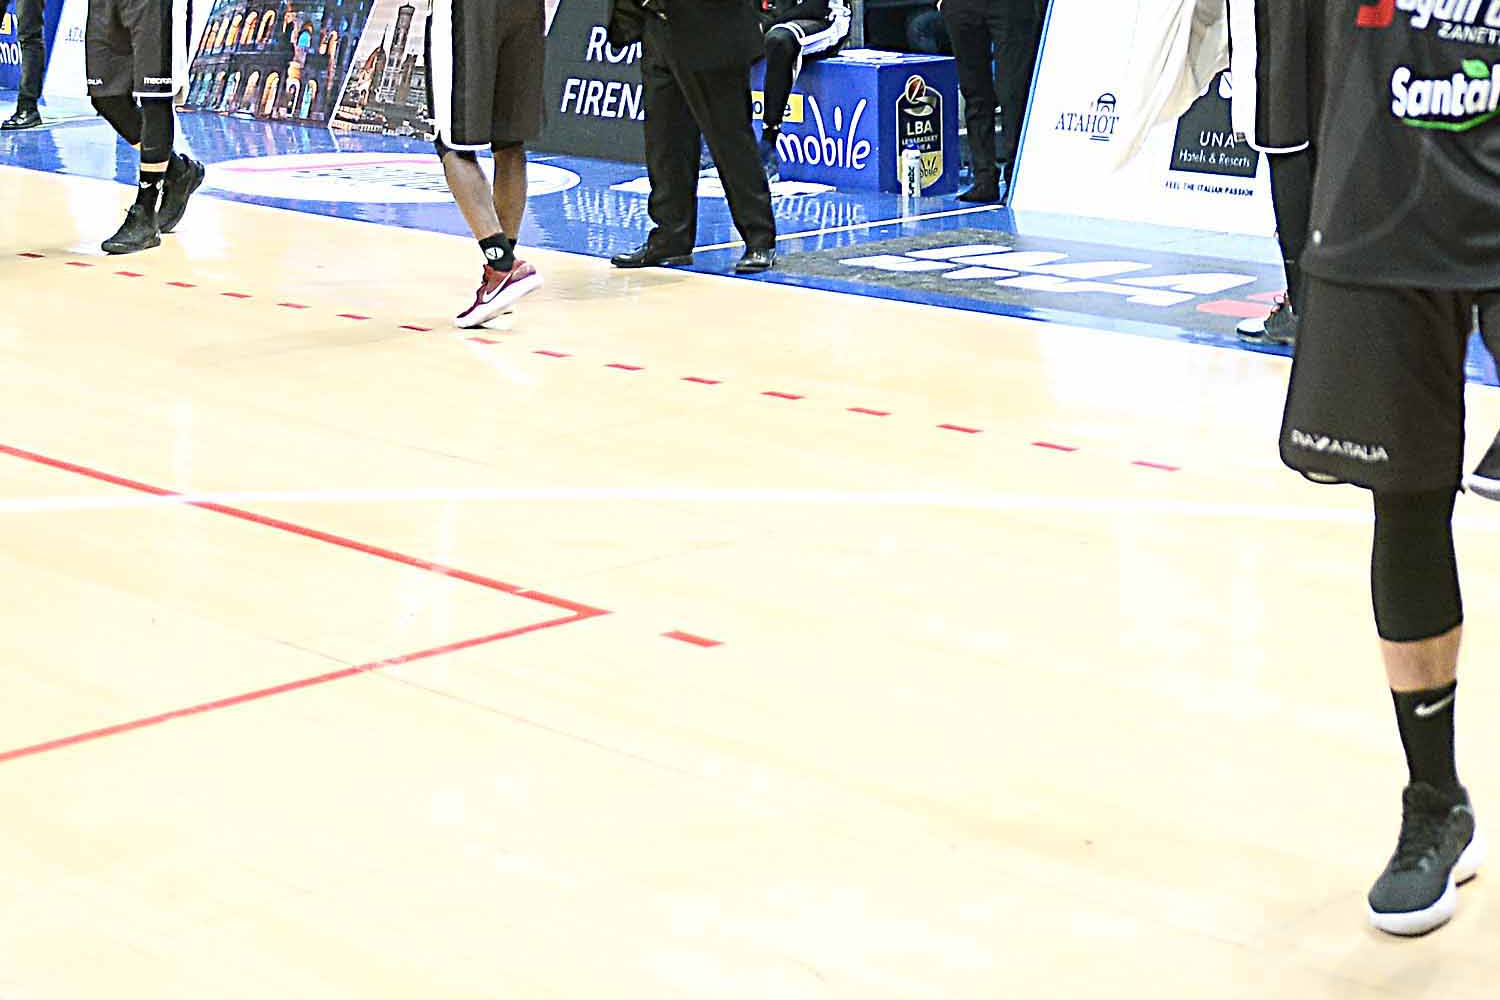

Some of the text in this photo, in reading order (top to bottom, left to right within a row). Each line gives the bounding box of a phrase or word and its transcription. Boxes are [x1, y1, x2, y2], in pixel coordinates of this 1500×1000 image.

[560, 77, 646, 121] FIREN
[775, 95, 871, 170] mobile
[906, 119, 934, 136] LBA
[1054, 111, 1120, 135] ATAHOT
[1199, 130, 1236, 149] UNA
[1208, 153, 1217, 164] &
